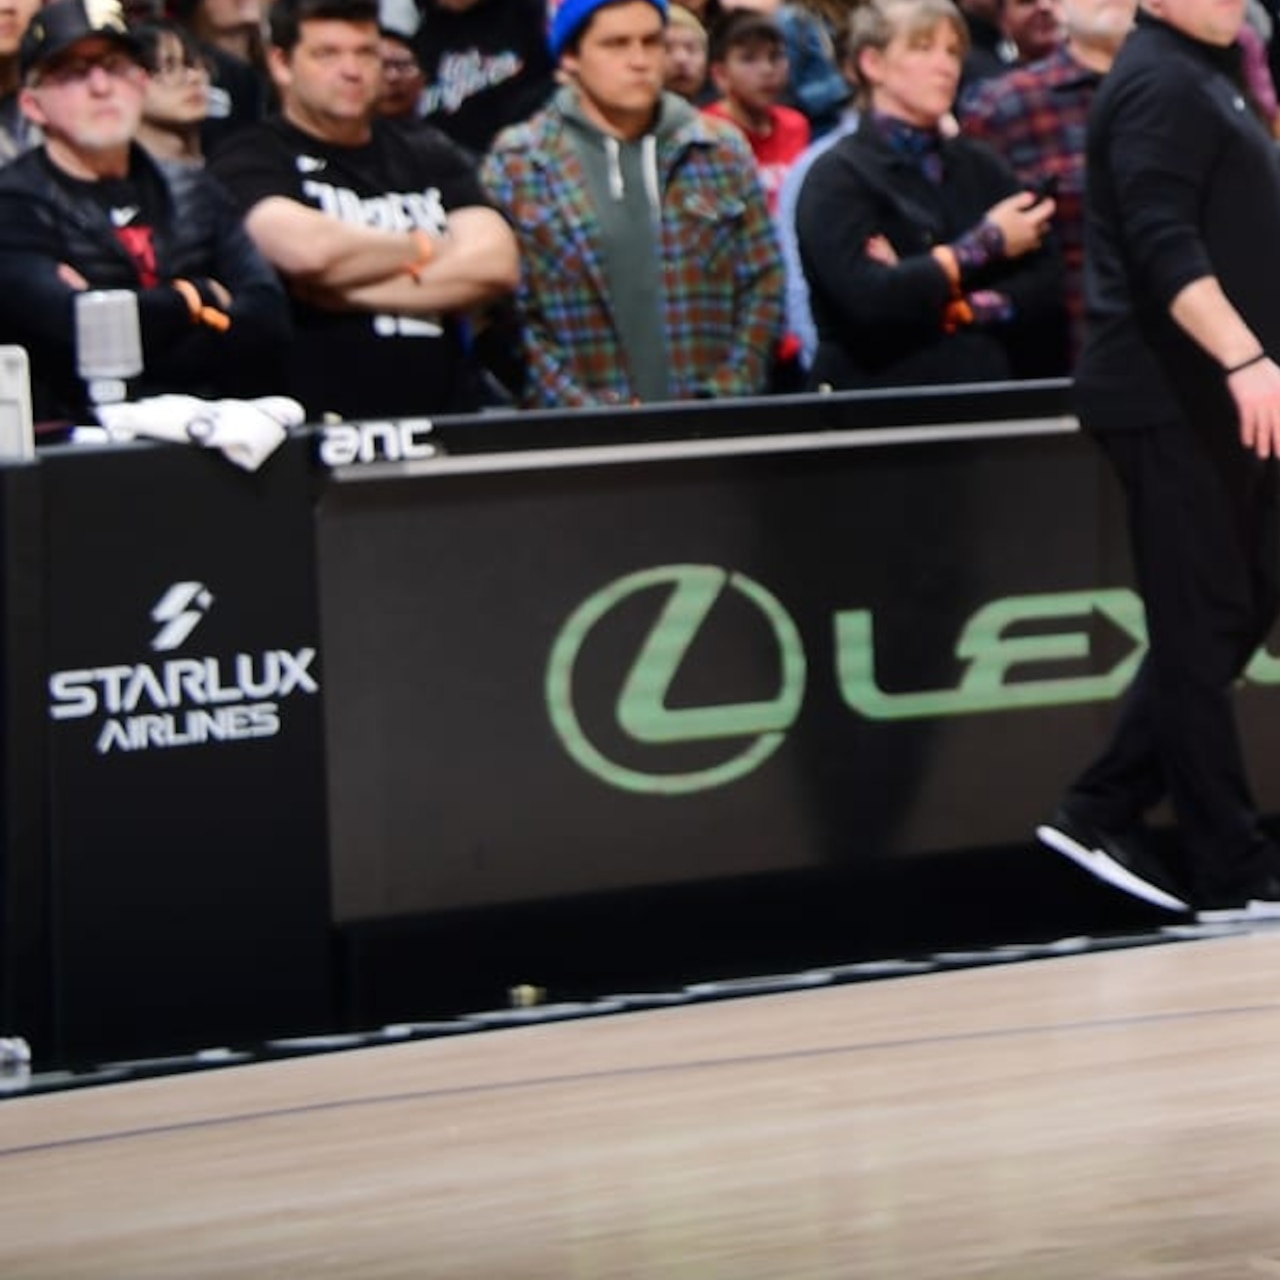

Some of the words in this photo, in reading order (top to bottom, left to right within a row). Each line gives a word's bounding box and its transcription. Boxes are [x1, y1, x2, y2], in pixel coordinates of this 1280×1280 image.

[320, 418, 436, 466] anc
[50, 647, 319, 719] STARLUX
[96, 702, 281, 754] AIRLINES
